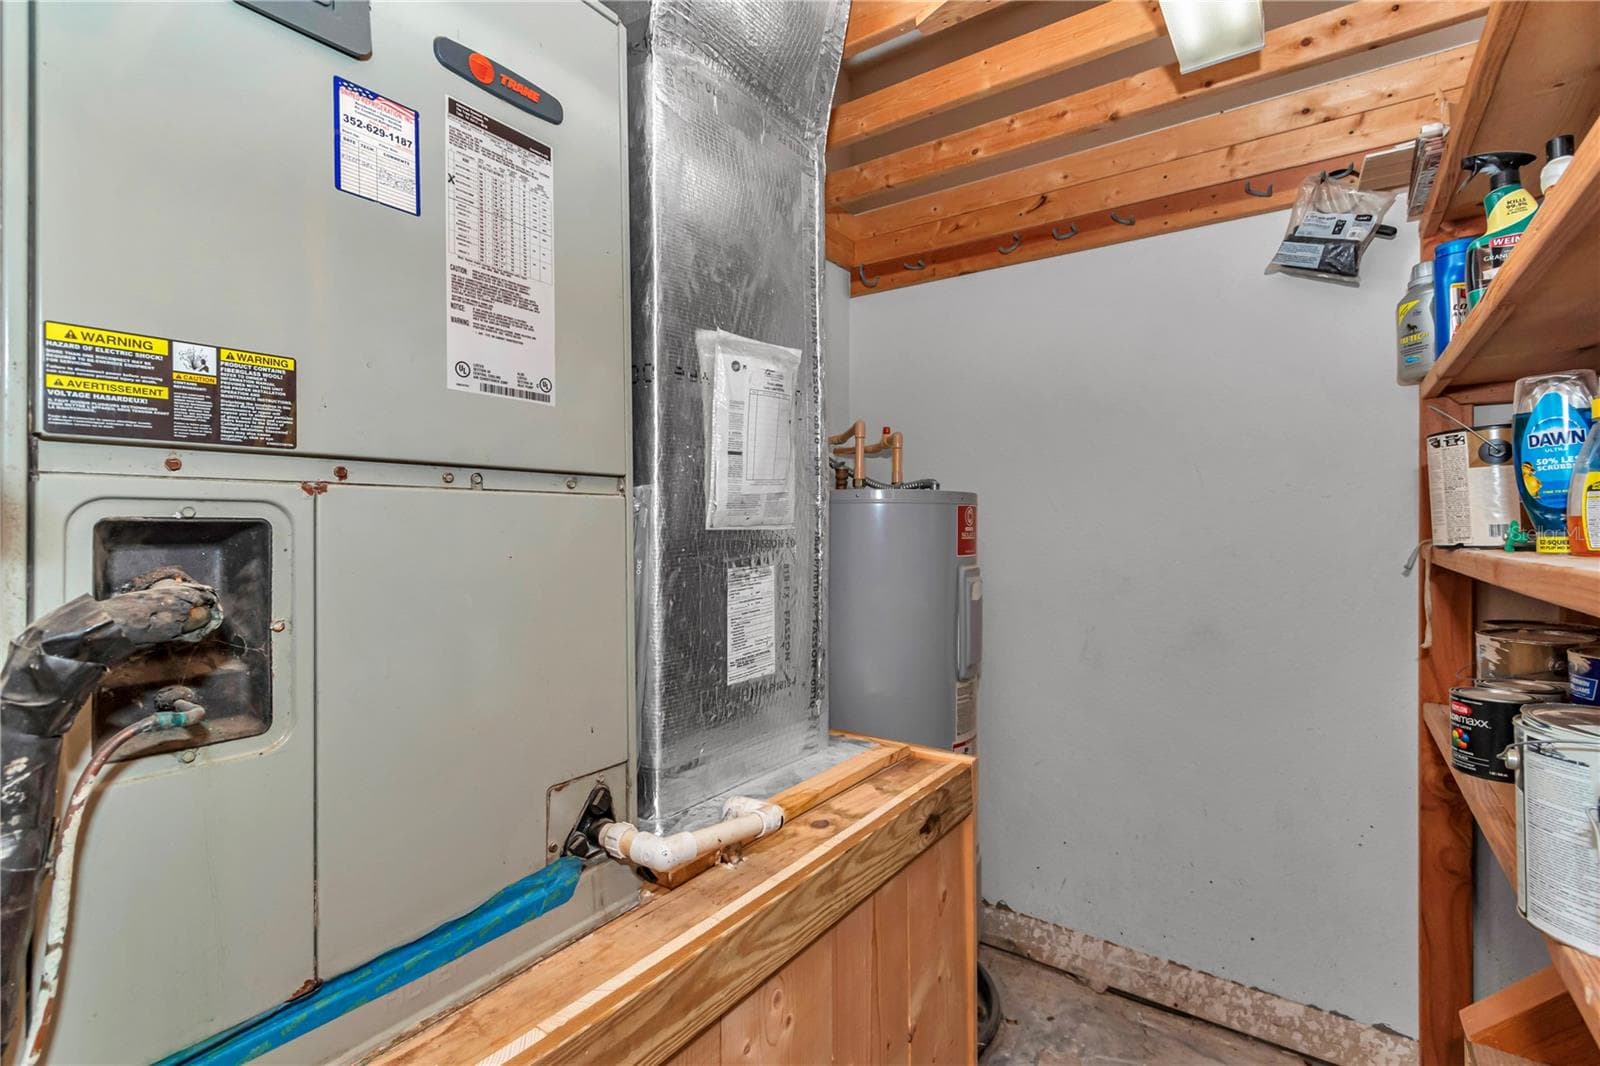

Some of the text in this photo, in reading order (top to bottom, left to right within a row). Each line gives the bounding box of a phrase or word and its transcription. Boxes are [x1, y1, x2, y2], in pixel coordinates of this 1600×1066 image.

[499, 73, 541, 103] TRANE
[343, 113, 412, 149] 352-629-1187
[46, 339, 80, 349] HAZARD
[95, 347, 133, 356] ELECTRIC
[80, 331, 154, 351] WARNING
[236, 352, 289, 368] WARNING
[67, 379, 165, 397] AVERTISSEMENT
[183, 374, 215, 384] CAUTION
[812, 355, 820, 405] FASSON
[46, 389, 147, 404] VOLTAGE HASARDEUX!
[1528, 429, 1586, 449] DAWN
[1536, 457, 1559, 466] 50%
[784, 610, 792, 662] FASSON
[811, 618, 819, 669] FASSON
